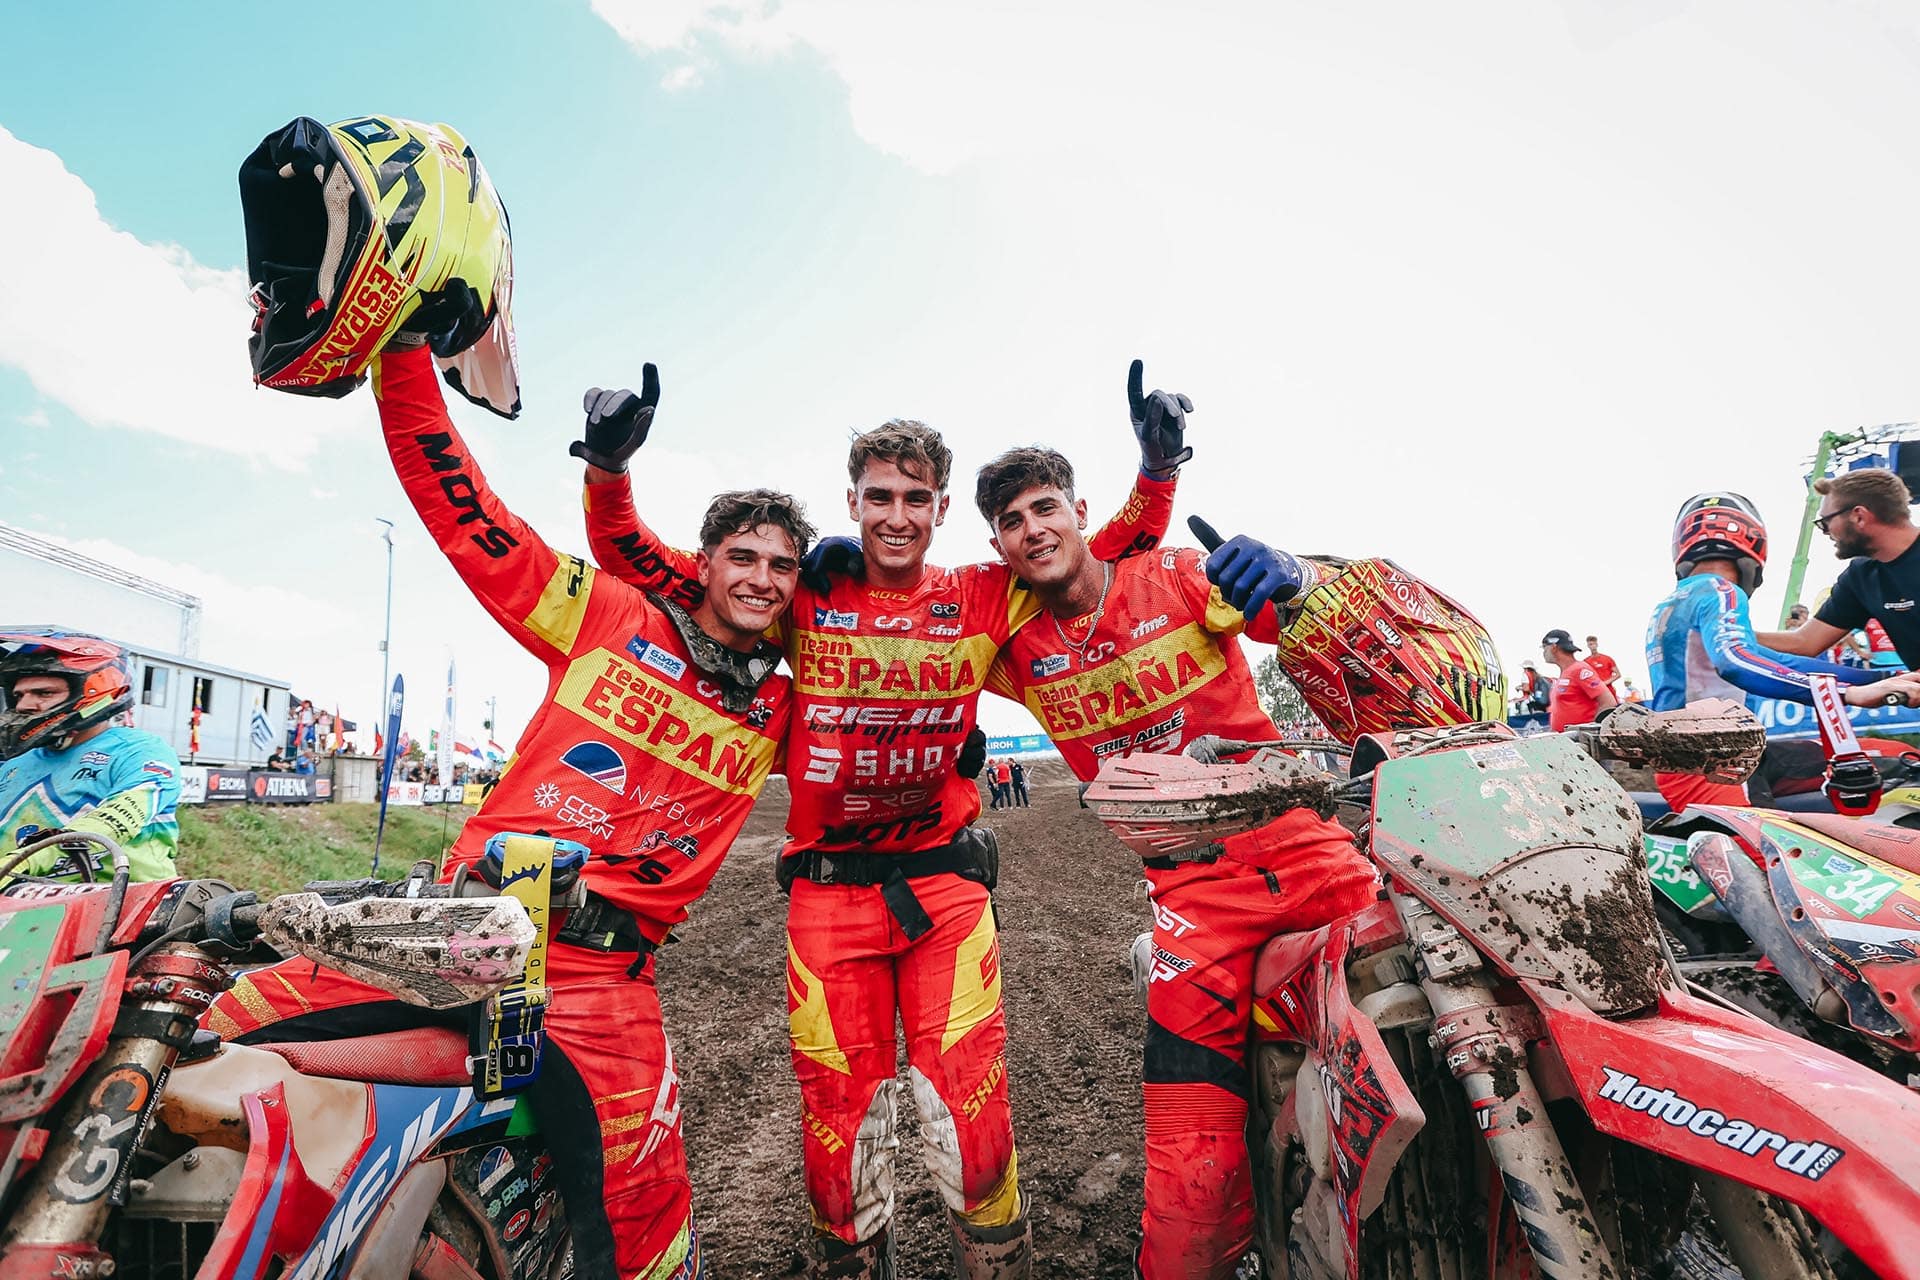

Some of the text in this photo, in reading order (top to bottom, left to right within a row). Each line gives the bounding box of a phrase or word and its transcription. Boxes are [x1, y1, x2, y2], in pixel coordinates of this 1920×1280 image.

[373, 279, 406, 324] Team
[414, 432, 520, 559] MOTS
[610, 531, 706, 605] MOTS
[800, 634, 853, 656] Team
[602, 657, 673, 709] Team
[800, 653, 976, 692] ESPAÑA
[1034, 683, 1079, 704] Team
[1041, 650, 1205, 734] ESPAÑA
[582, 675, 757, 788] ESPAÑA
[803, 703, 965, 725] RIEJU
[1094, 735, 1131, 755] ERIC
[1134, 707, 1185, 744] AUGÉ
[265, 777, 308, 796] ATHENA
[556, 807, 614, 840] CHAIN
[564, 795, 615, 830] COOL
[1647, 850, 1700, 889] 254
[1825, 869, 1898, 914] 34
[529, 906, 544, 1005] CADEMY
[1280, 989, 1297, 1014] ERIC
[487, 1049, 497, 1086] YAGO
[1598, 1066, 1830, 1176] Motocard
